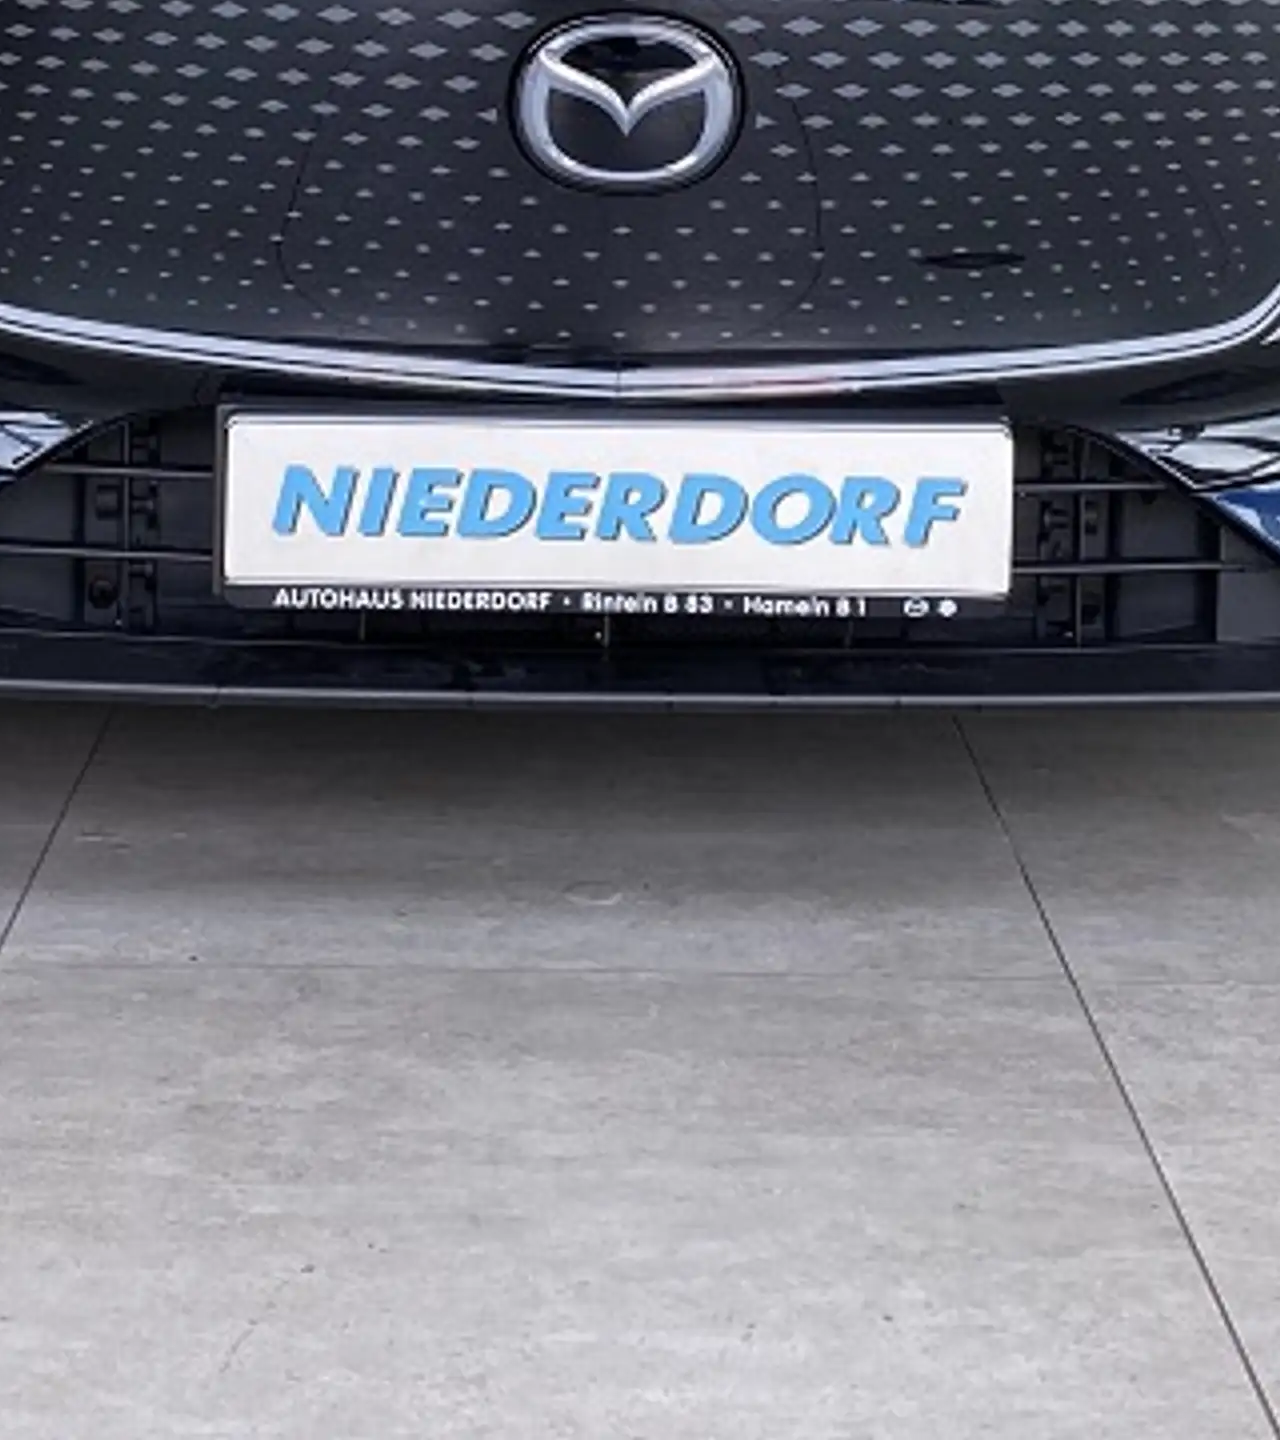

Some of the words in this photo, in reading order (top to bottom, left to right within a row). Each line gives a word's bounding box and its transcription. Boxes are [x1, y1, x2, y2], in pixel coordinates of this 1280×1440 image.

[272, 464, 969, 548] NIEDERDORF
[274, 588, 405, 610] AUTOHAUS
[411, 591, 553, 612] NIEDERDORF
[743, 596, 830, 617] Hameln
